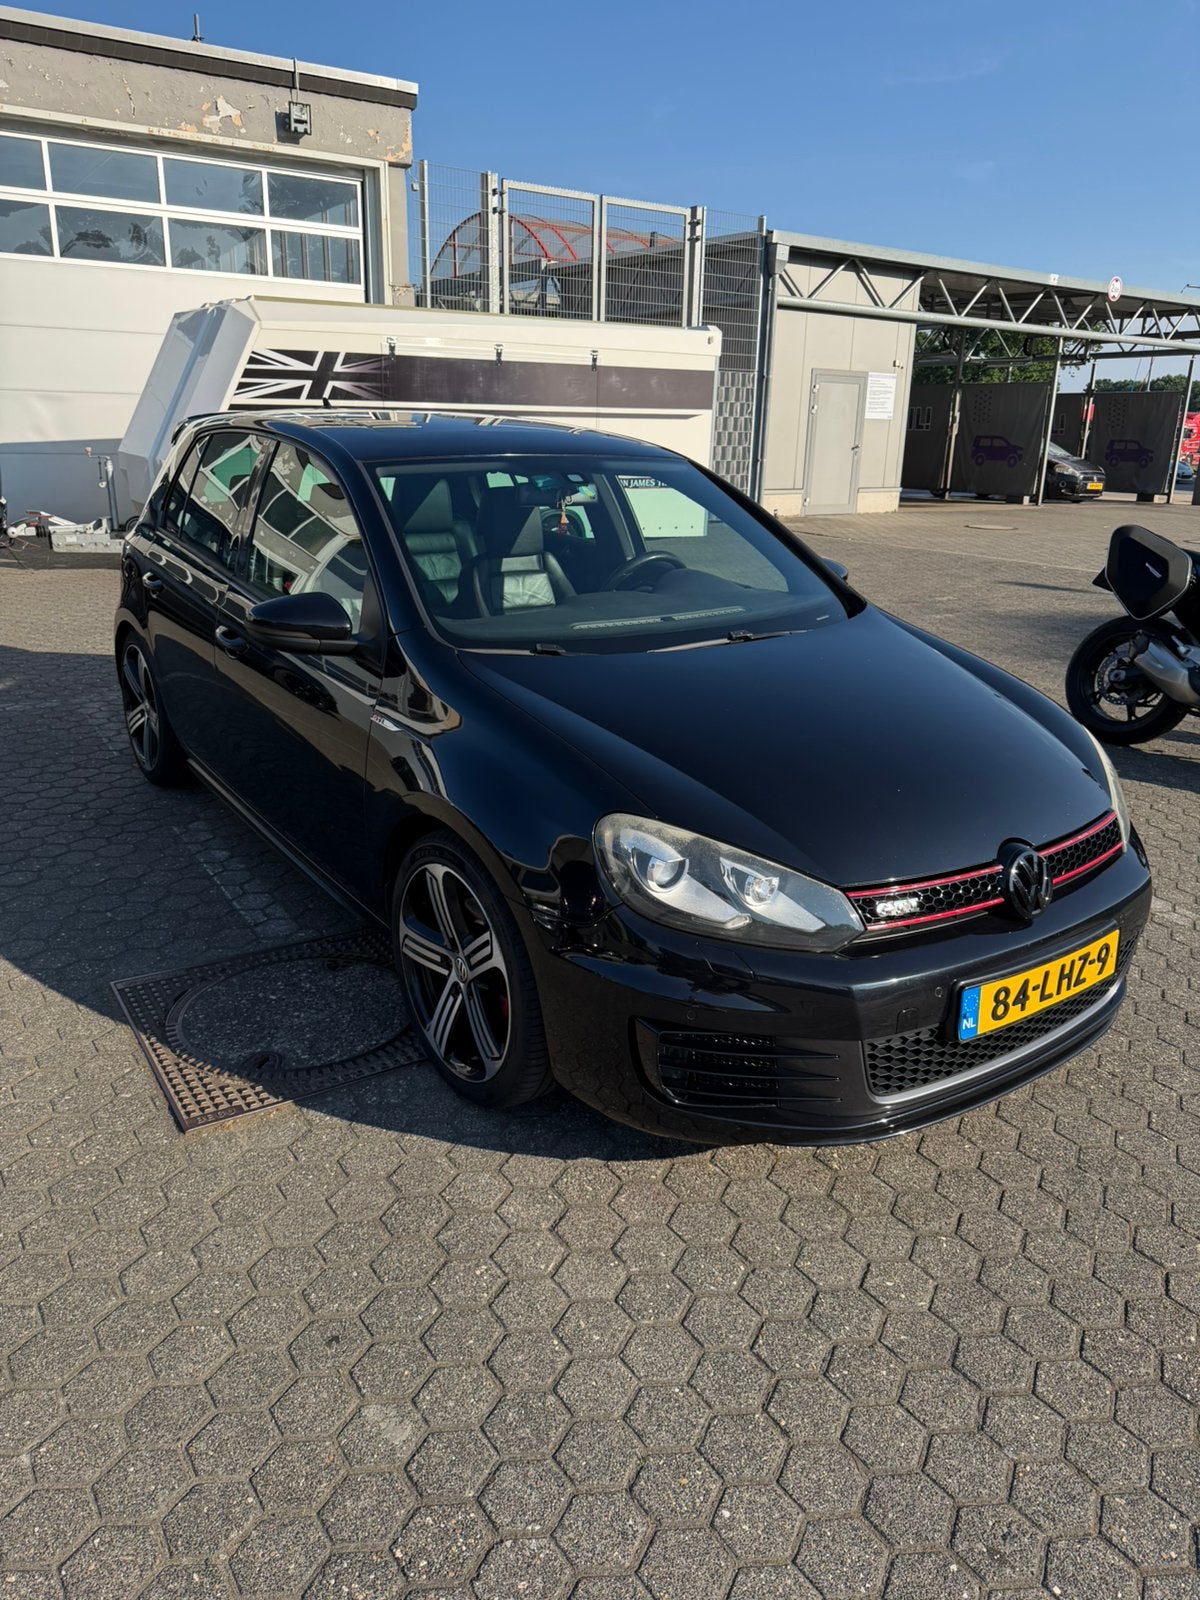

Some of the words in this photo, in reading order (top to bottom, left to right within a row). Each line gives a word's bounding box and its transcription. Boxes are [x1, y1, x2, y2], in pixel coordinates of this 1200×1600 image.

[630, 478, 656, 488] JAMES
[991, 942, 1110, 1021] 84-LHZ-9
[962, 1018, 976, 1030] NL
